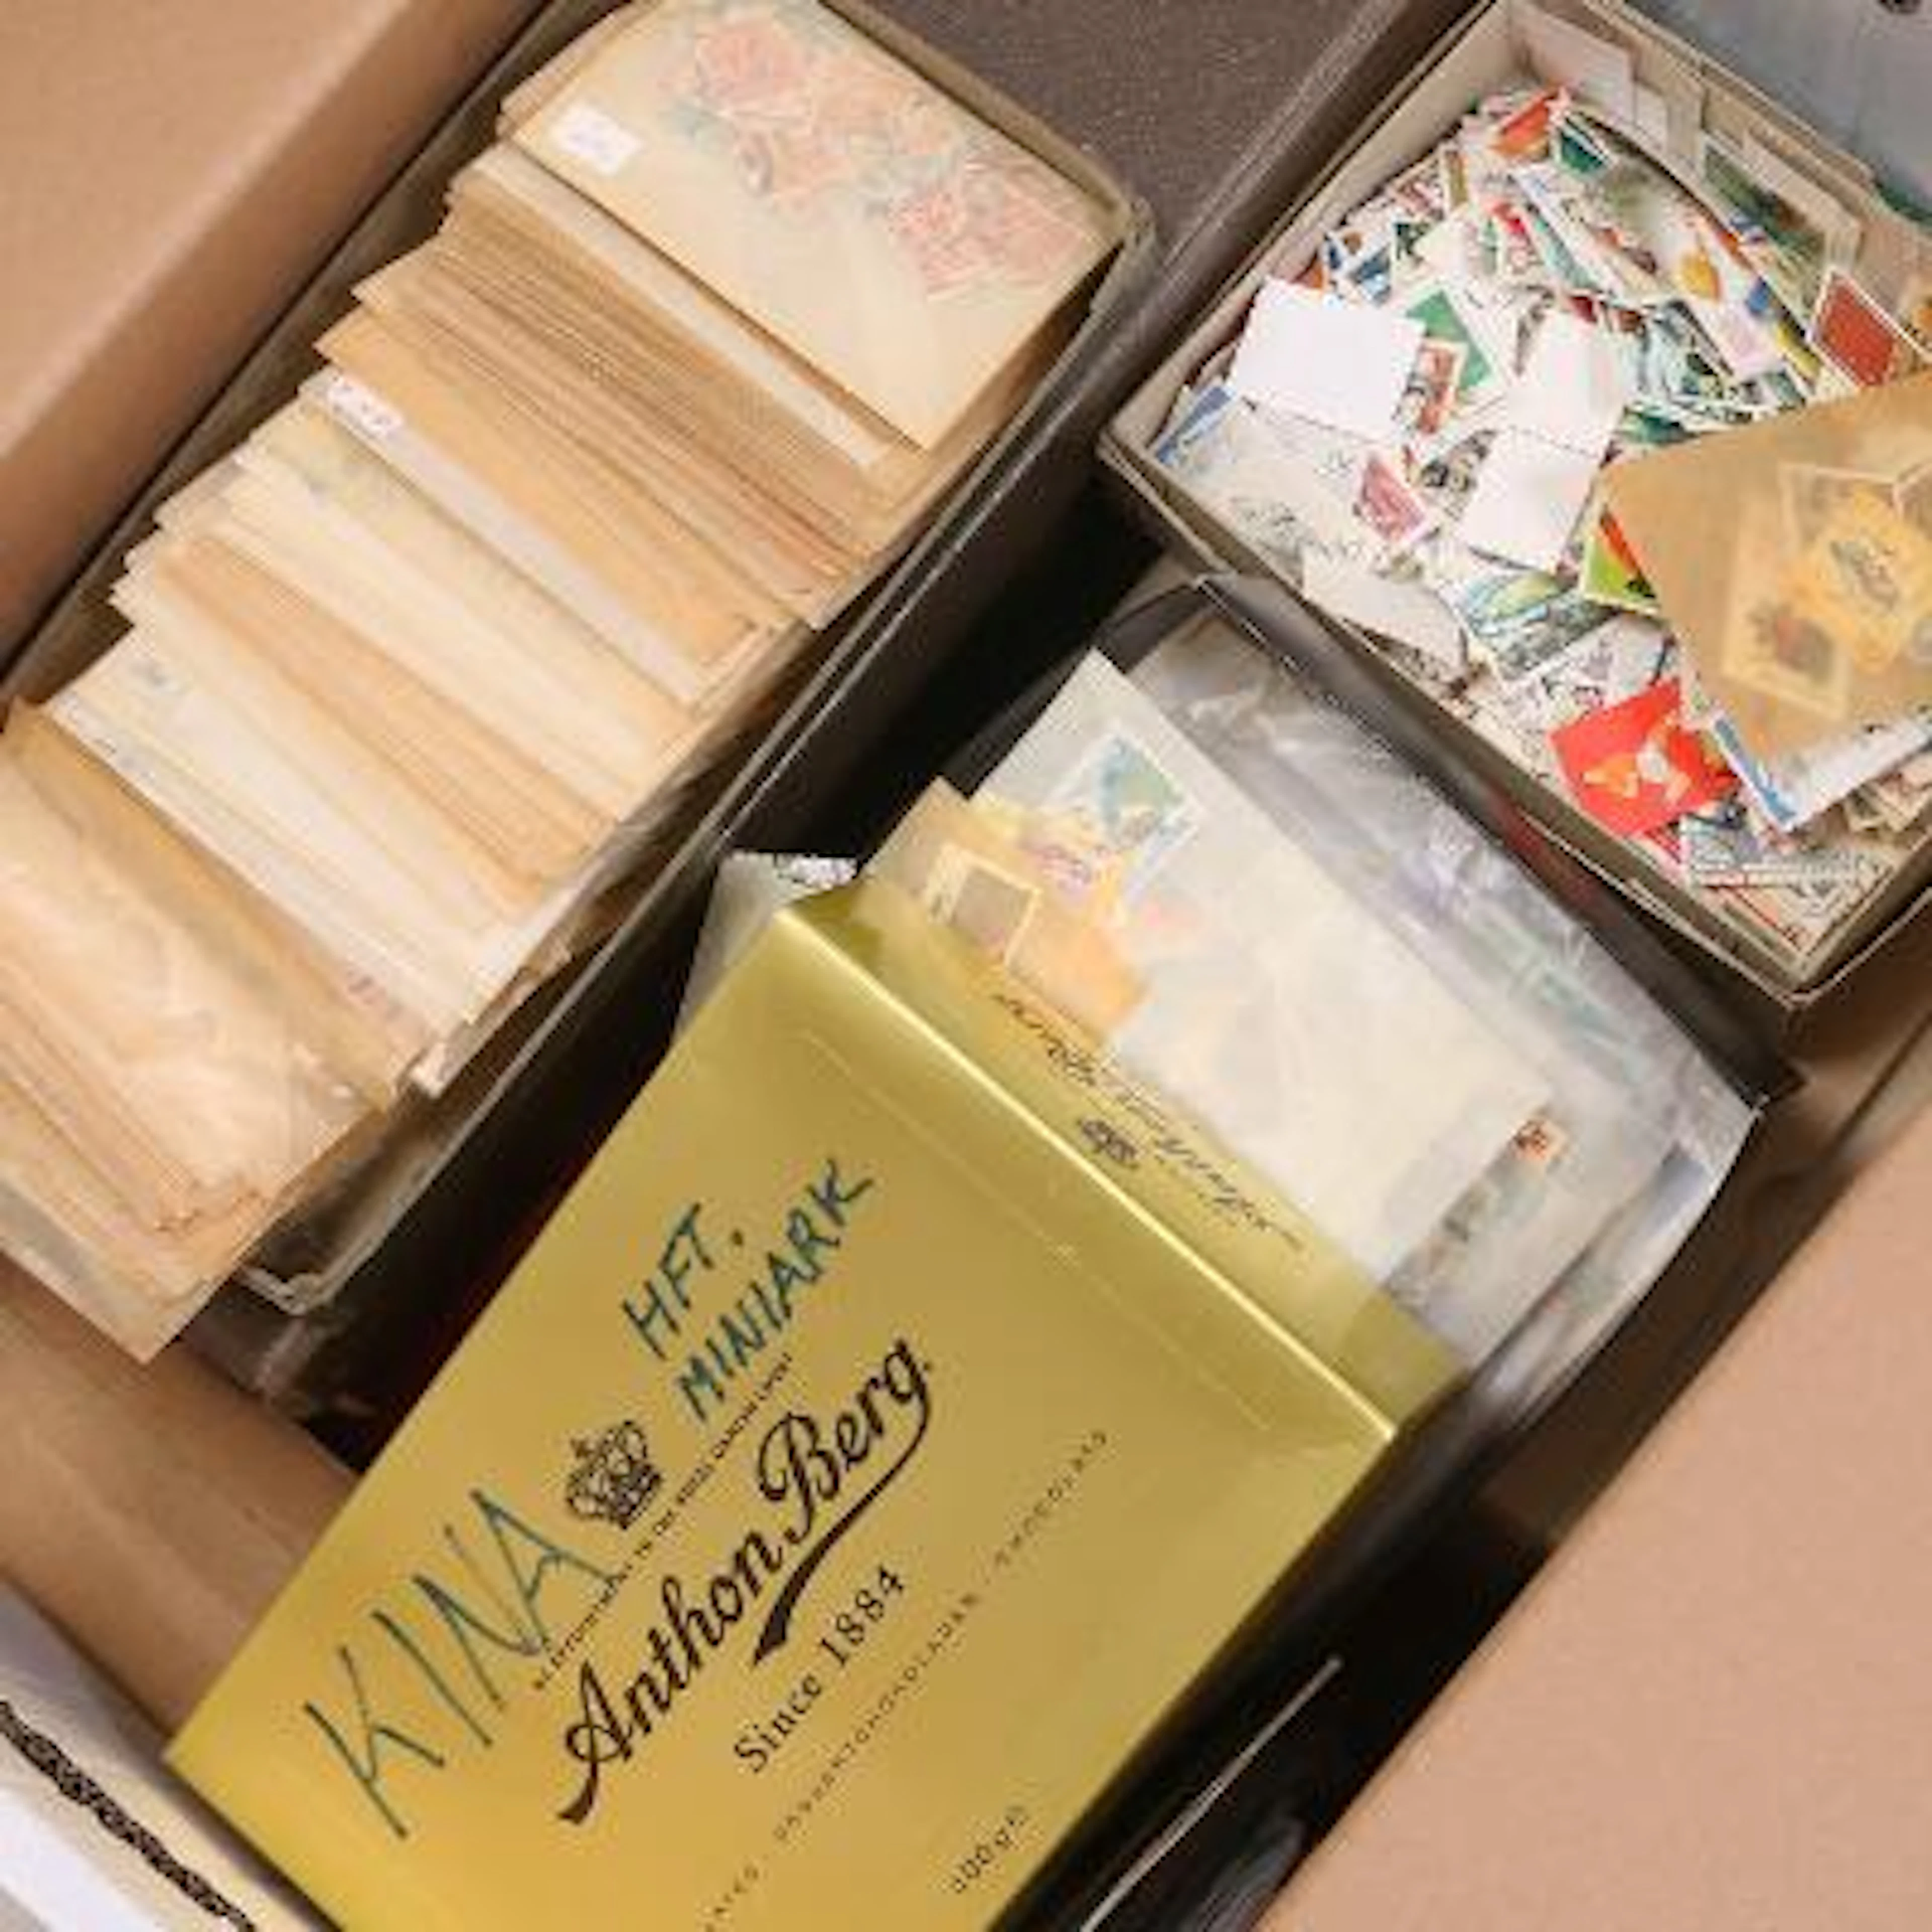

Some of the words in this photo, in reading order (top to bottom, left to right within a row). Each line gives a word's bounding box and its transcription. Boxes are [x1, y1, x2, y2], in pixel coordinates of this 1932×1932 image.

[621, 1201, 744, 1360] HFT.
[677, 1157, 874, 1422] MINIARK
[303, 1488, 619, 1839] KINA
[557, 1532, 783, 1826] Anthon
[754, 1337, 931, 1665] Berg
[734, 1673, 822, 1773] Since
[821, 1564, 905, 1668] 1884
